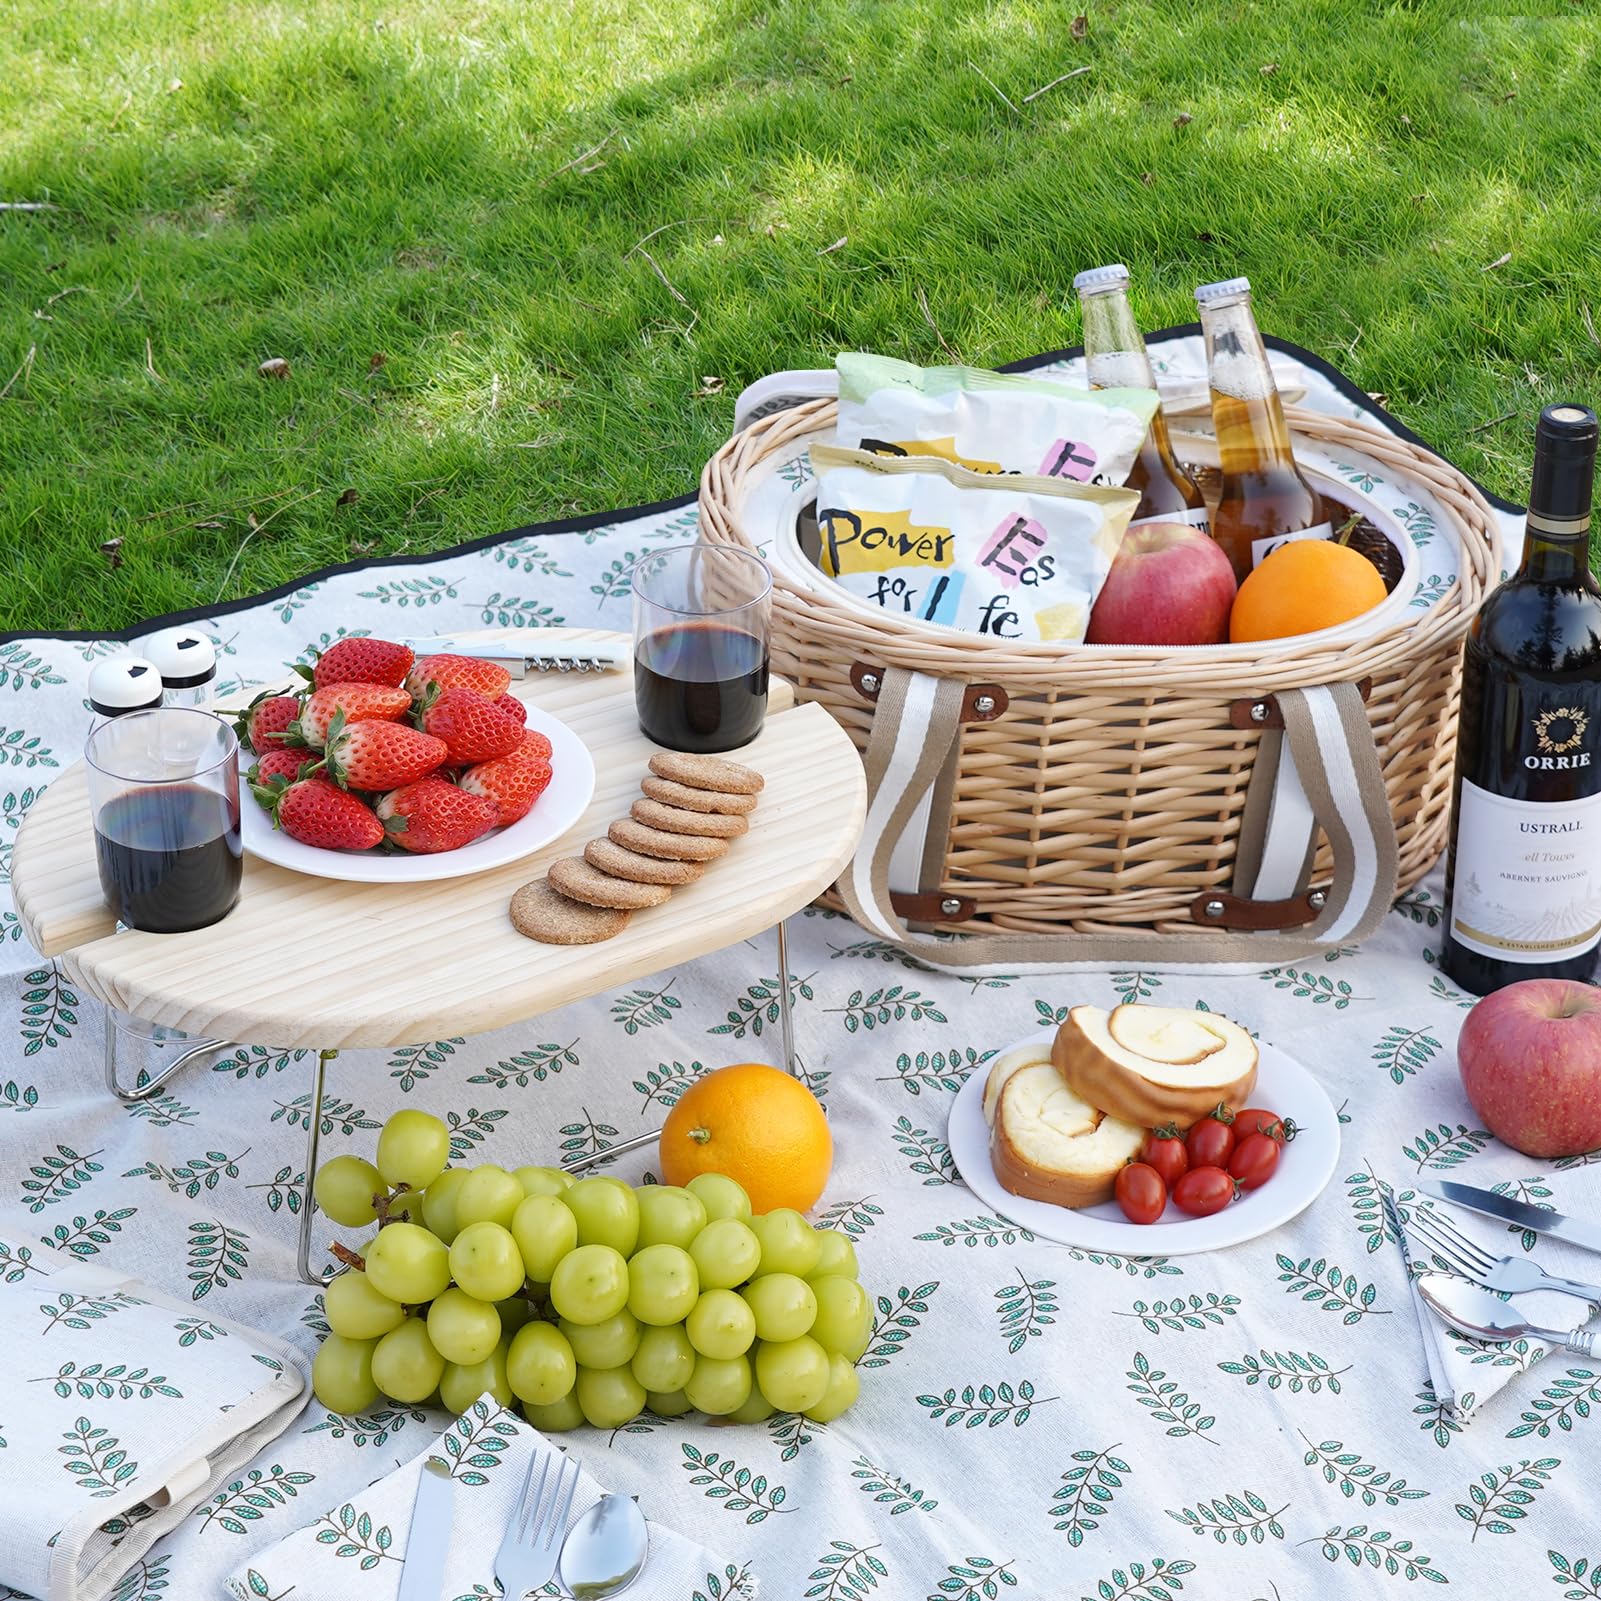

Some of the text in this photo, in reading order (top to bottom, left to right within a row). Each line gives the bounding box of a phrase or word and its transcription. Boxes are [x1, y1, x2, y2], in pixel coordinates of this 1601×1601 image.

[819, 508, 955, 577] Power
[868, 576, 918, 612] for
[1524, 752, 1591, 770] ORRIE
